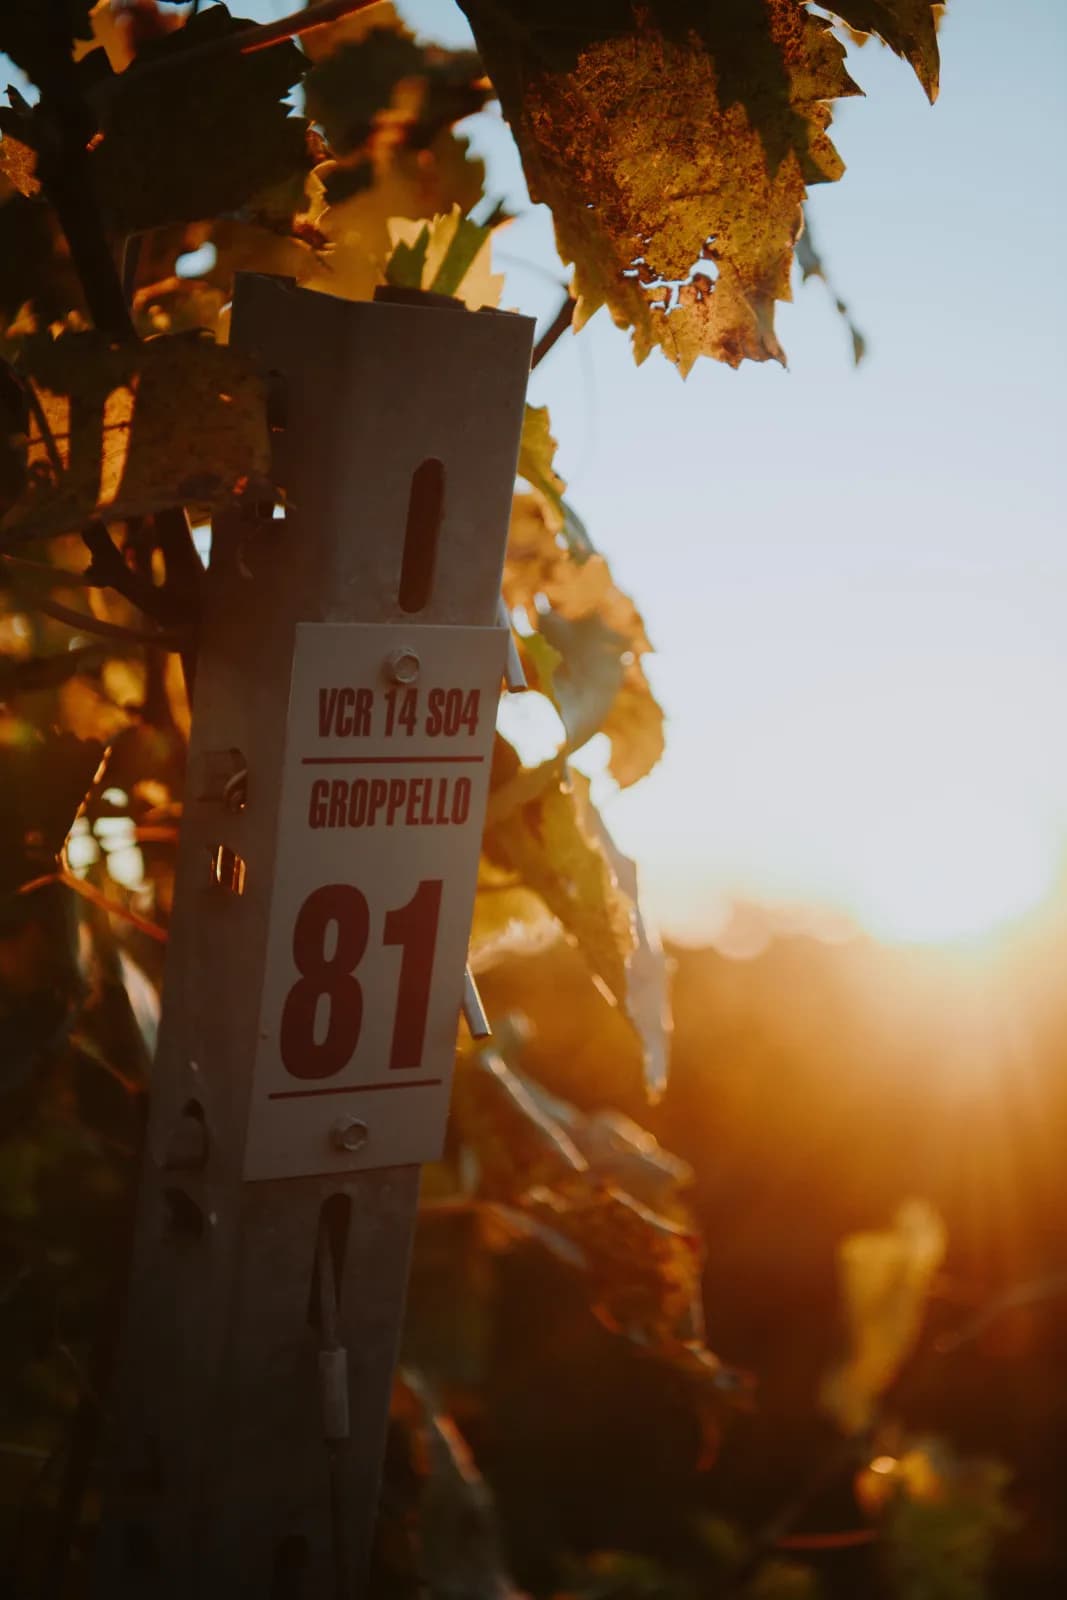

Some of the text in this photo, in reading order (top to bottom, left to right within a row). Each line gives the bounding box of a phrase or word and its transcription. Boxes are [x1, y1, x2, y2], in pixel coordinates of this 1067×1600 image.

[318, 687, 373, 737] VCR
[384, 687, 418, 737] 14
[308, 777, 472, 829] GROPPELLO
[280, 880, 443, 1080] 81
